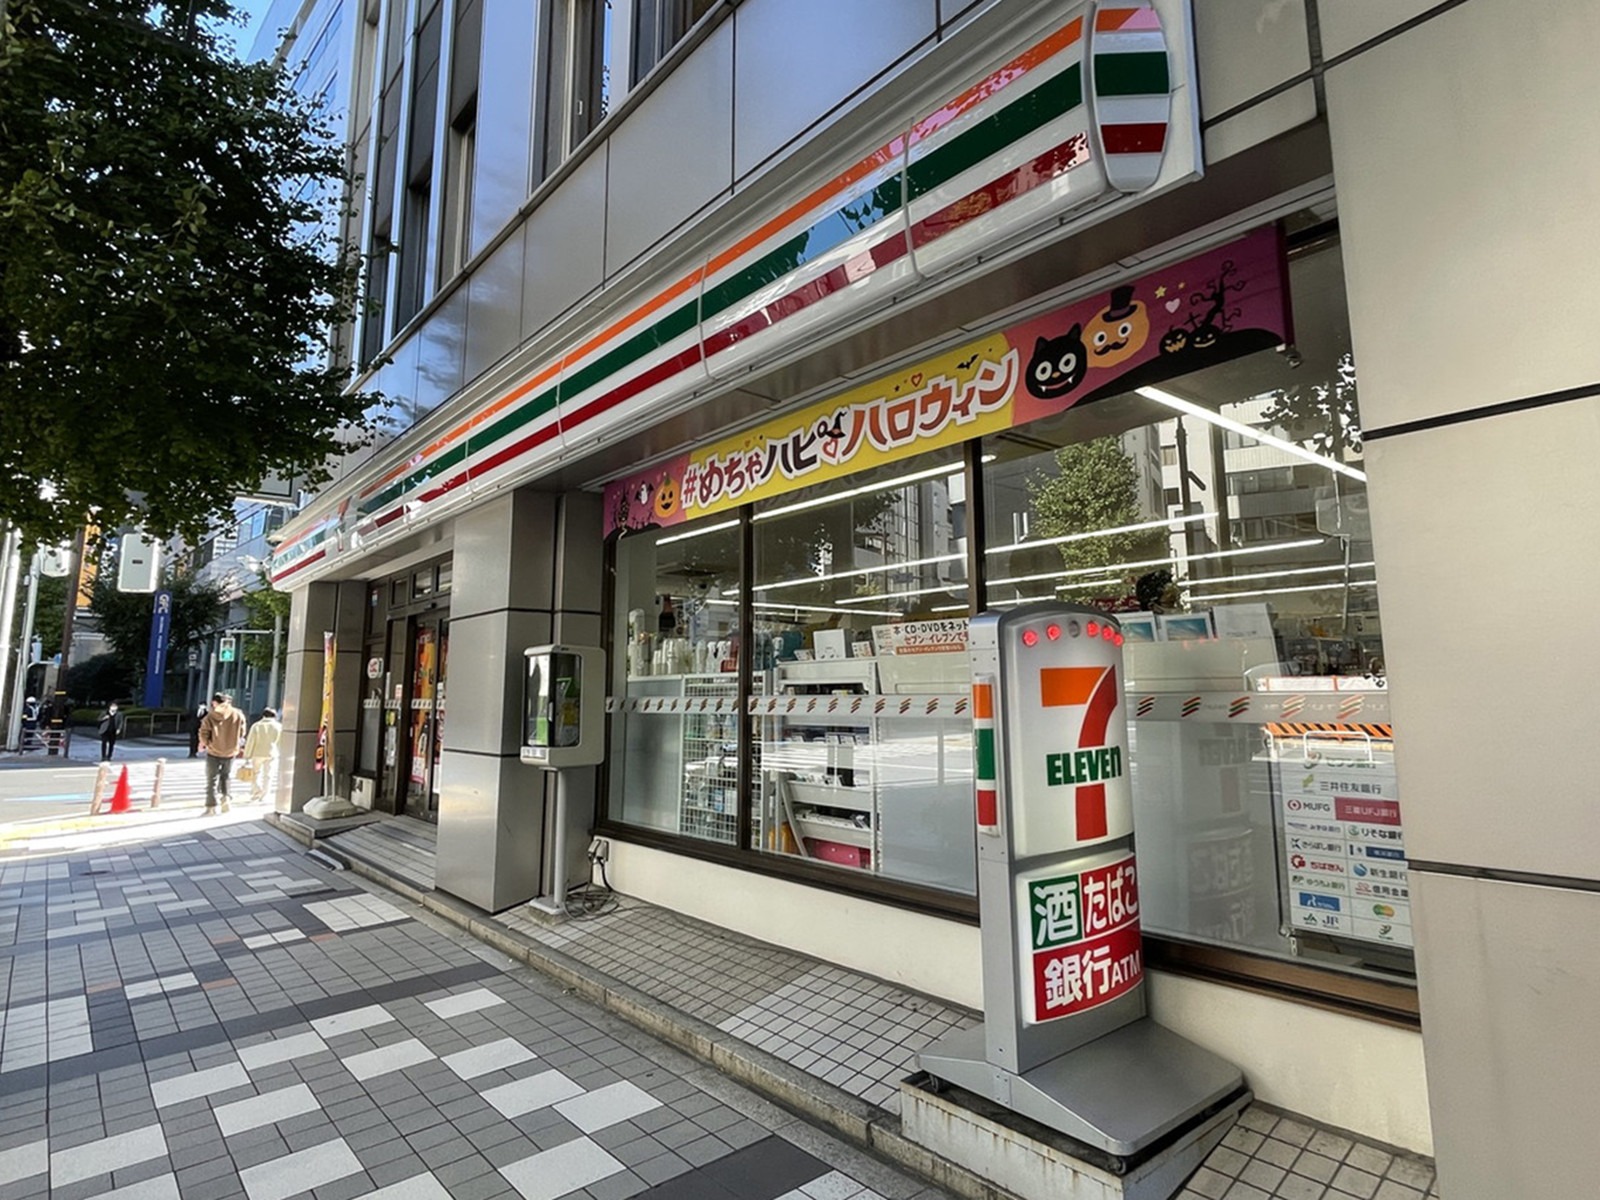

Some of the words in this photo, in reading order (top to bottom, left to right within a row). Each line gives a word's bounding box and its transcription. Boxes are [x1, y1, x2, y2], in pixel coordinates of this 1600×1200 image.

[1320, 781, 1381, 794] 三井住友銀行
[1303, 801, 1331, 812] MUFG
[1036, 884, 1079, 946] 酒
[1084, 867, 1139, 933] たばこ
